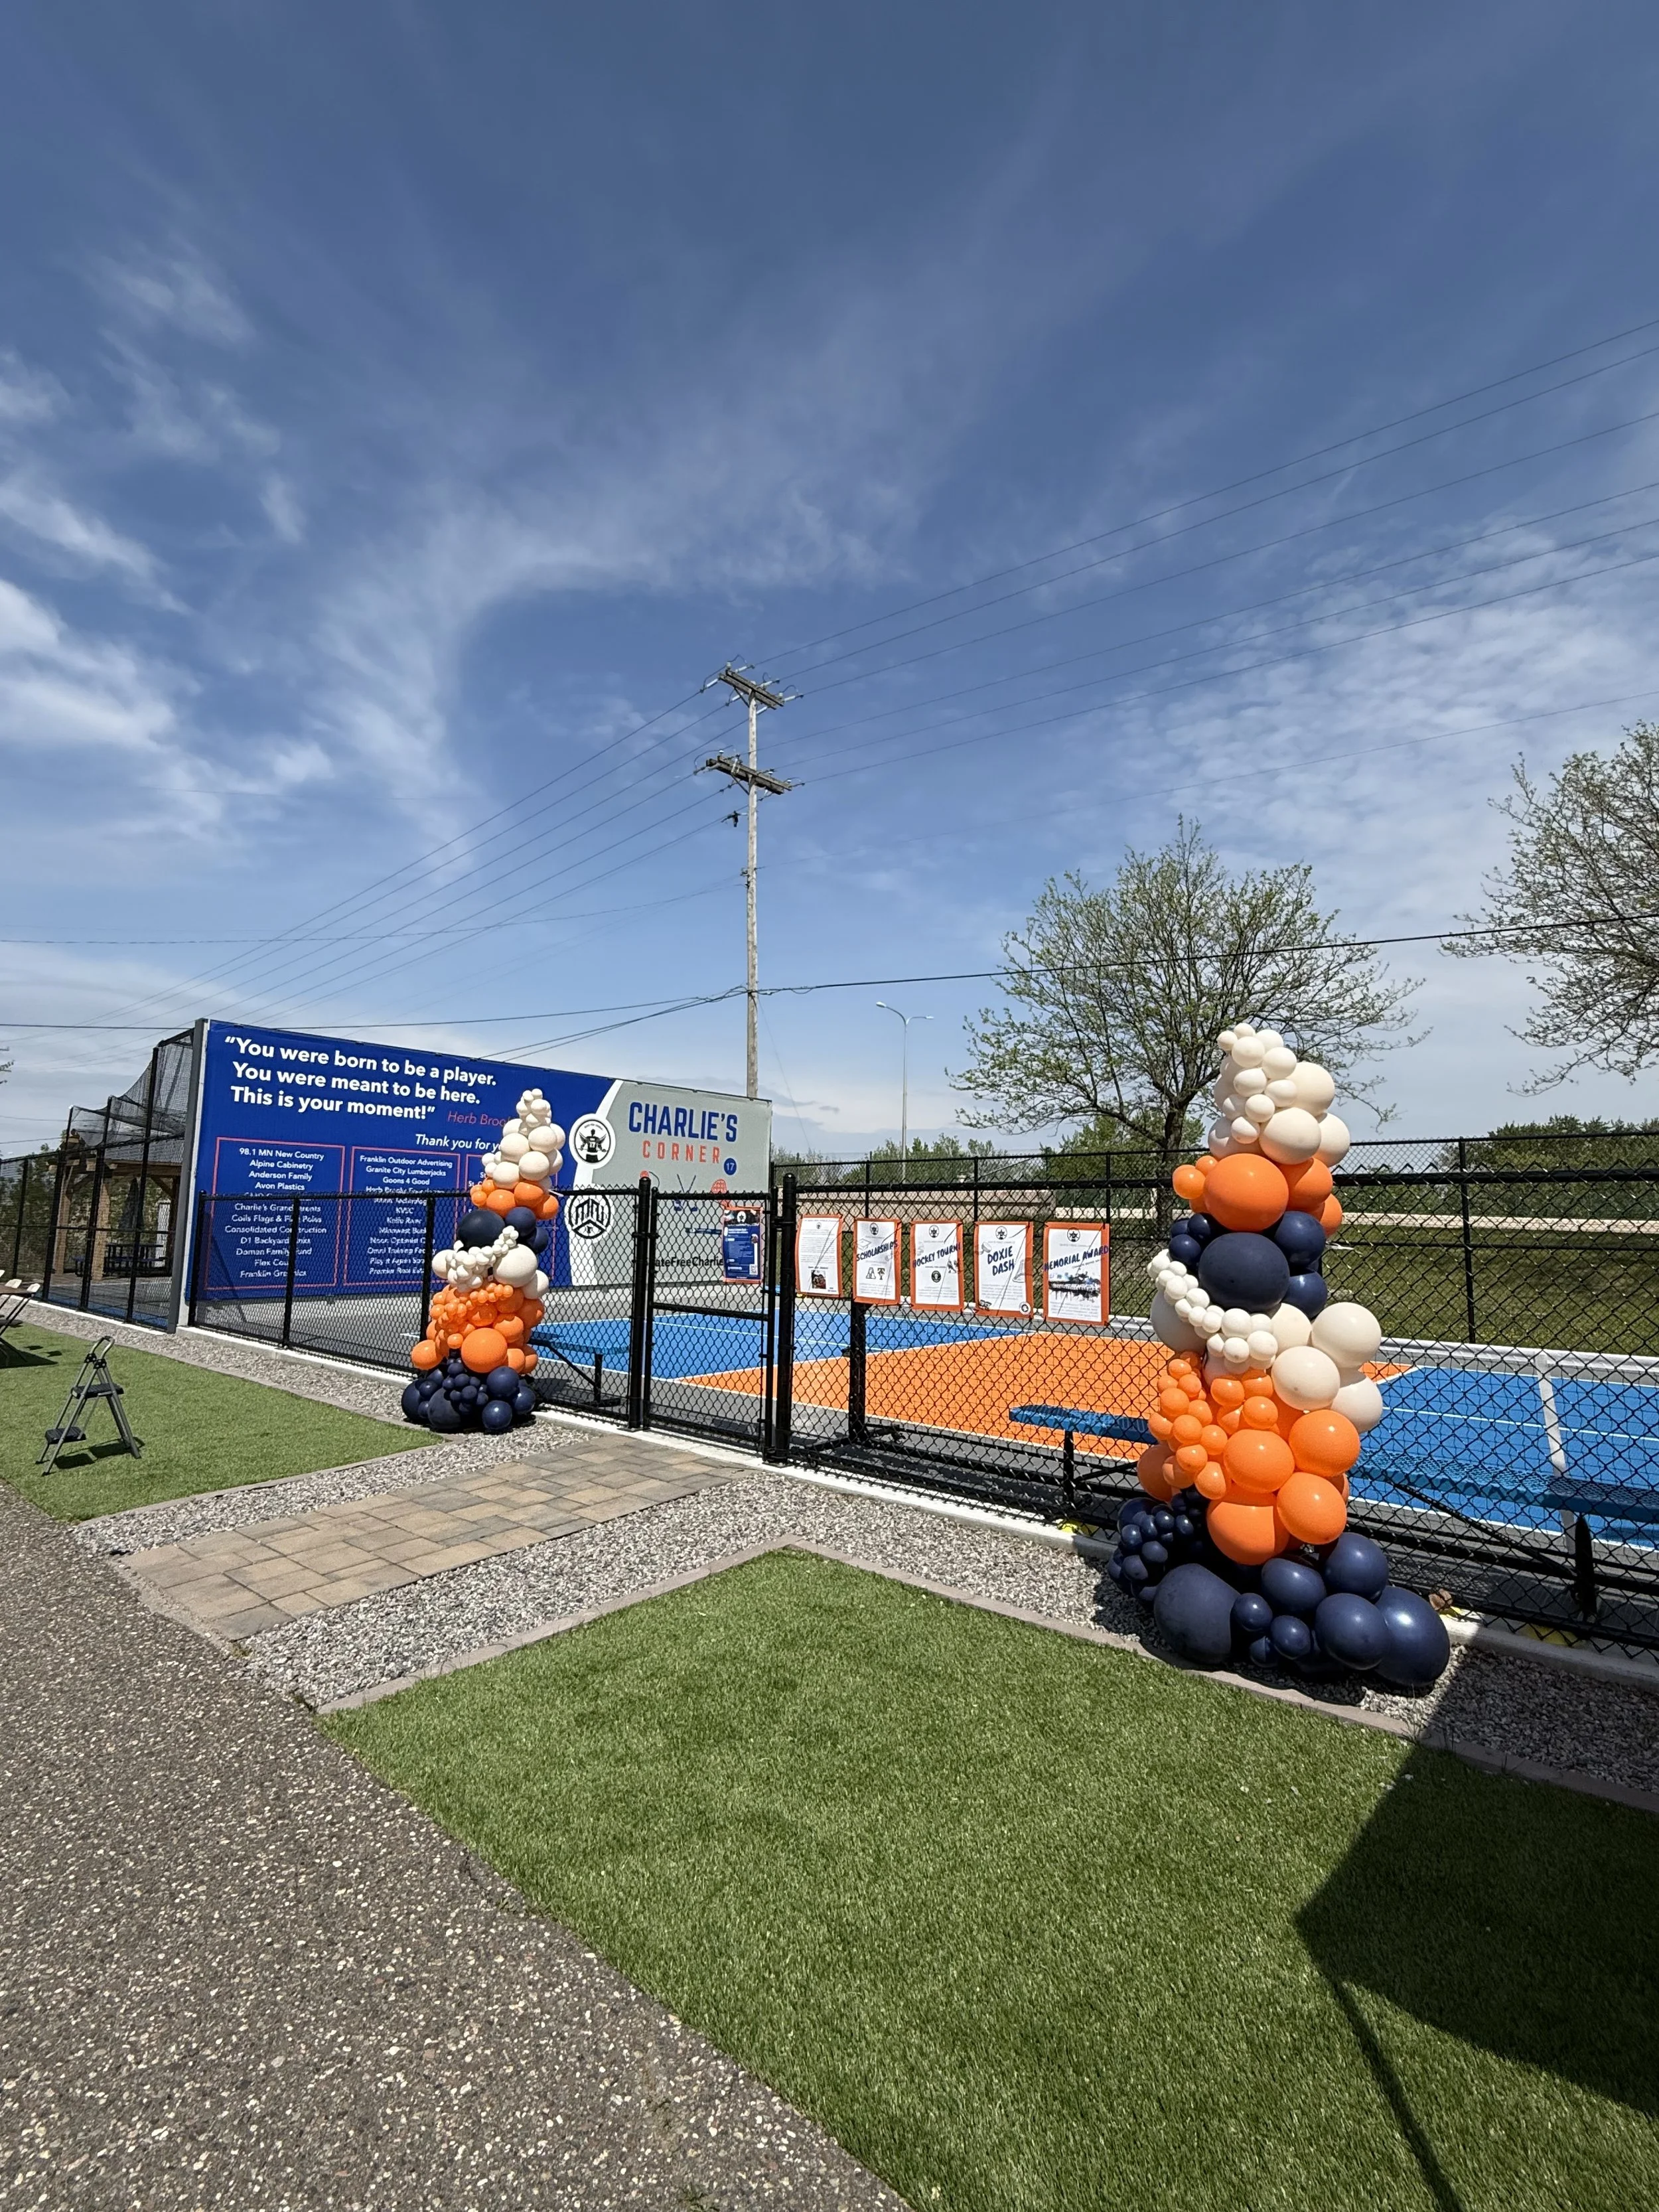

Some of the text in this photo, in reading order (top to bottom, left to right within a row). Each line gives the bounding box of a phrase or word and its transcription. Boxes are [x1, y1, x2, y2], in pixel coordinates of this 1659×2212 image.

[280, 1047, 329, 1065] were
[334, 1050, 377, 1070] born
[382, 1059, 399, 1073] to
[404, 1060, 426, 1076] be
[430, 1067, 439, 1078] a
[443, 1067, 496, 1086] player.
[233, 1061, 480, 1104] You were meant to be here.
[230, 1086, 272, 1105] This
[278, 1090, 294, 1107] is
[298, 1097, 343, 1113] your
[448, 1111, 510, 1127] Herb Broo
[628, 1102, 738, 1143] CHARLIE'S
[415, 1134, 449, 1147] Thank
[451, 1139, 472, 1151] you
[475, 1138, 490, 1149] for
[295, 1151, 325, 1161] Country
[642, 1140, 721, 1164] CORNER
[250, 1159, 313, 1171] Alpine Cabinetry
[392, 1167, 405, 1175] City
[407, 1167, 446, 1177] Lumberjacks
[417, 1159, 453, 1169] Advertising
[725, 1162, 735, 1171] 17
[288, 1172, 313, 1181] Family
[269, 1203, 321, 1213] Grandarents
[856, 1239, 899, 1262] SCHOLARSHIPS
[987, 1245, 1013, 1265] DOXIE
[1043, 1252, 1080, 1272] MEMORIAL
[1082, 1245, 1109, 1261] AWARD
[912, 1252, 936, 1268] HOCKEY
[992, 1258, 1015, 1276] DASH
